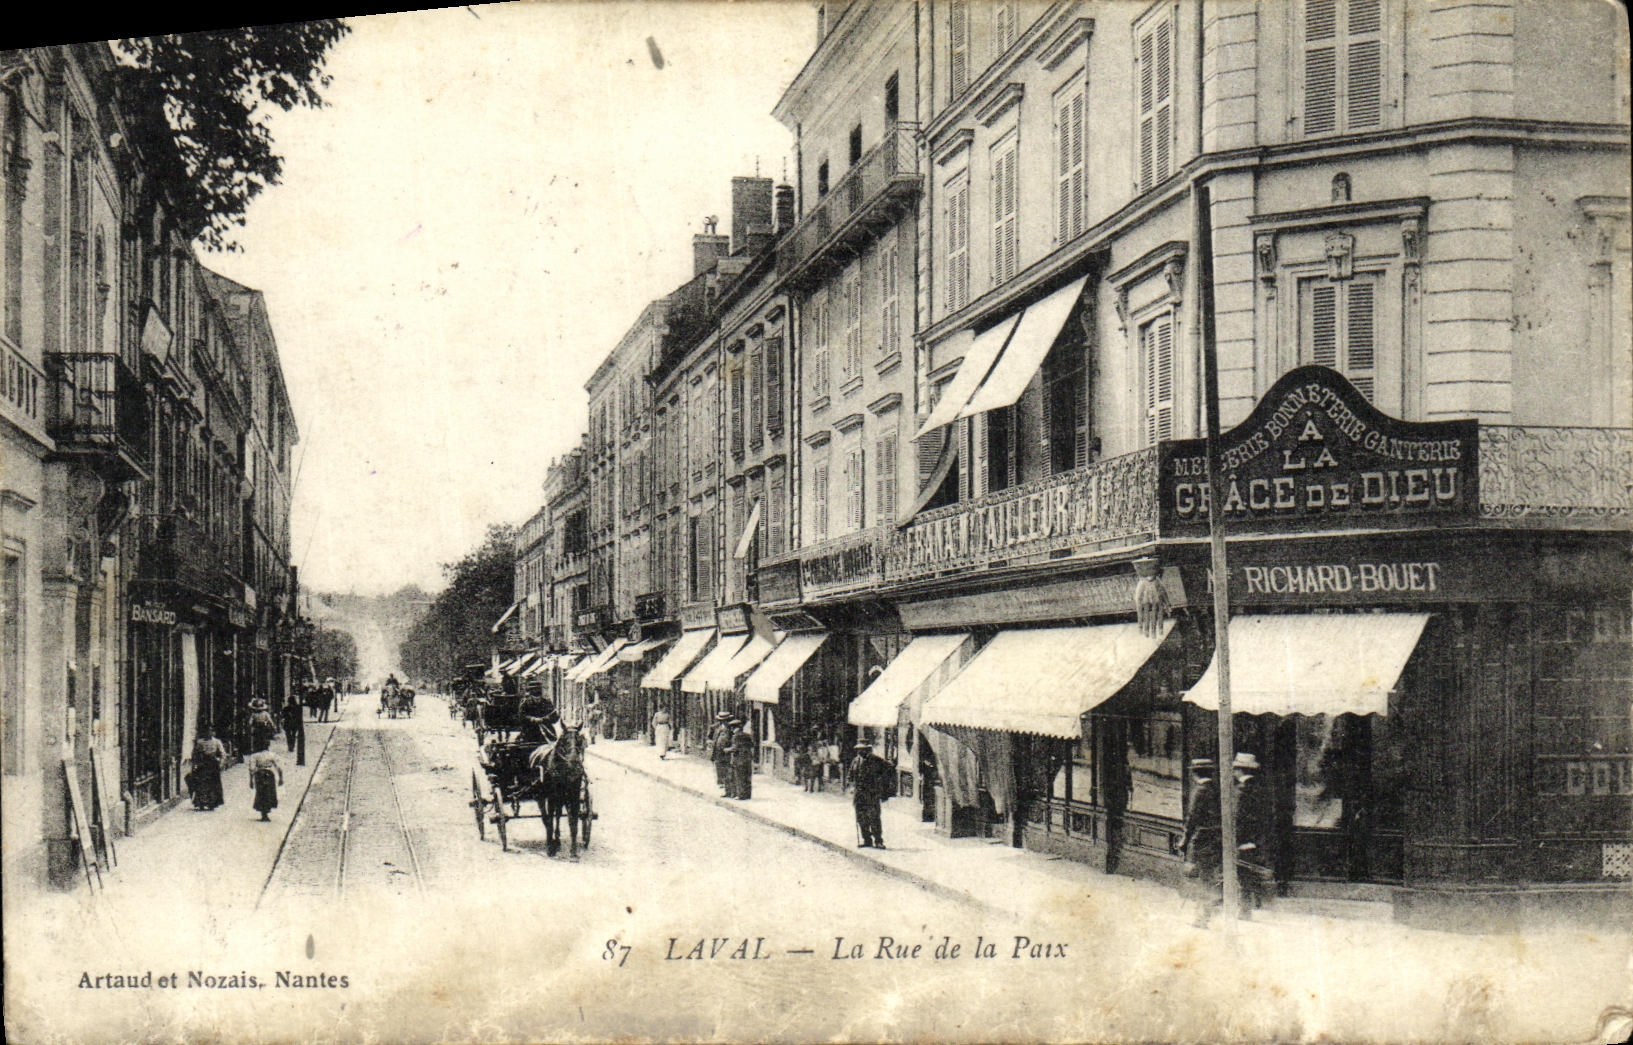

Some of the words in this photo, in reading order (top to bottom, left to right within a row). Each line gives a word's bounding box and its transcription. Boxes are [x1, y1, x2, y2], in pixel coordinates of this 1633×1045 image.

[1263, 382, 1367, 442] BONNETERIE
[1363, 430, 1461, 462] GANTERIE
[1282, 448, 1339, 470] LA
[1175, 473, 1296, 514] GRÂCE
[1305, 484, 1350, 507] DE
[1360, 467, 1458, 503] DIEU
[1243, 561, 1441, 594] RICHARD-BOUET
